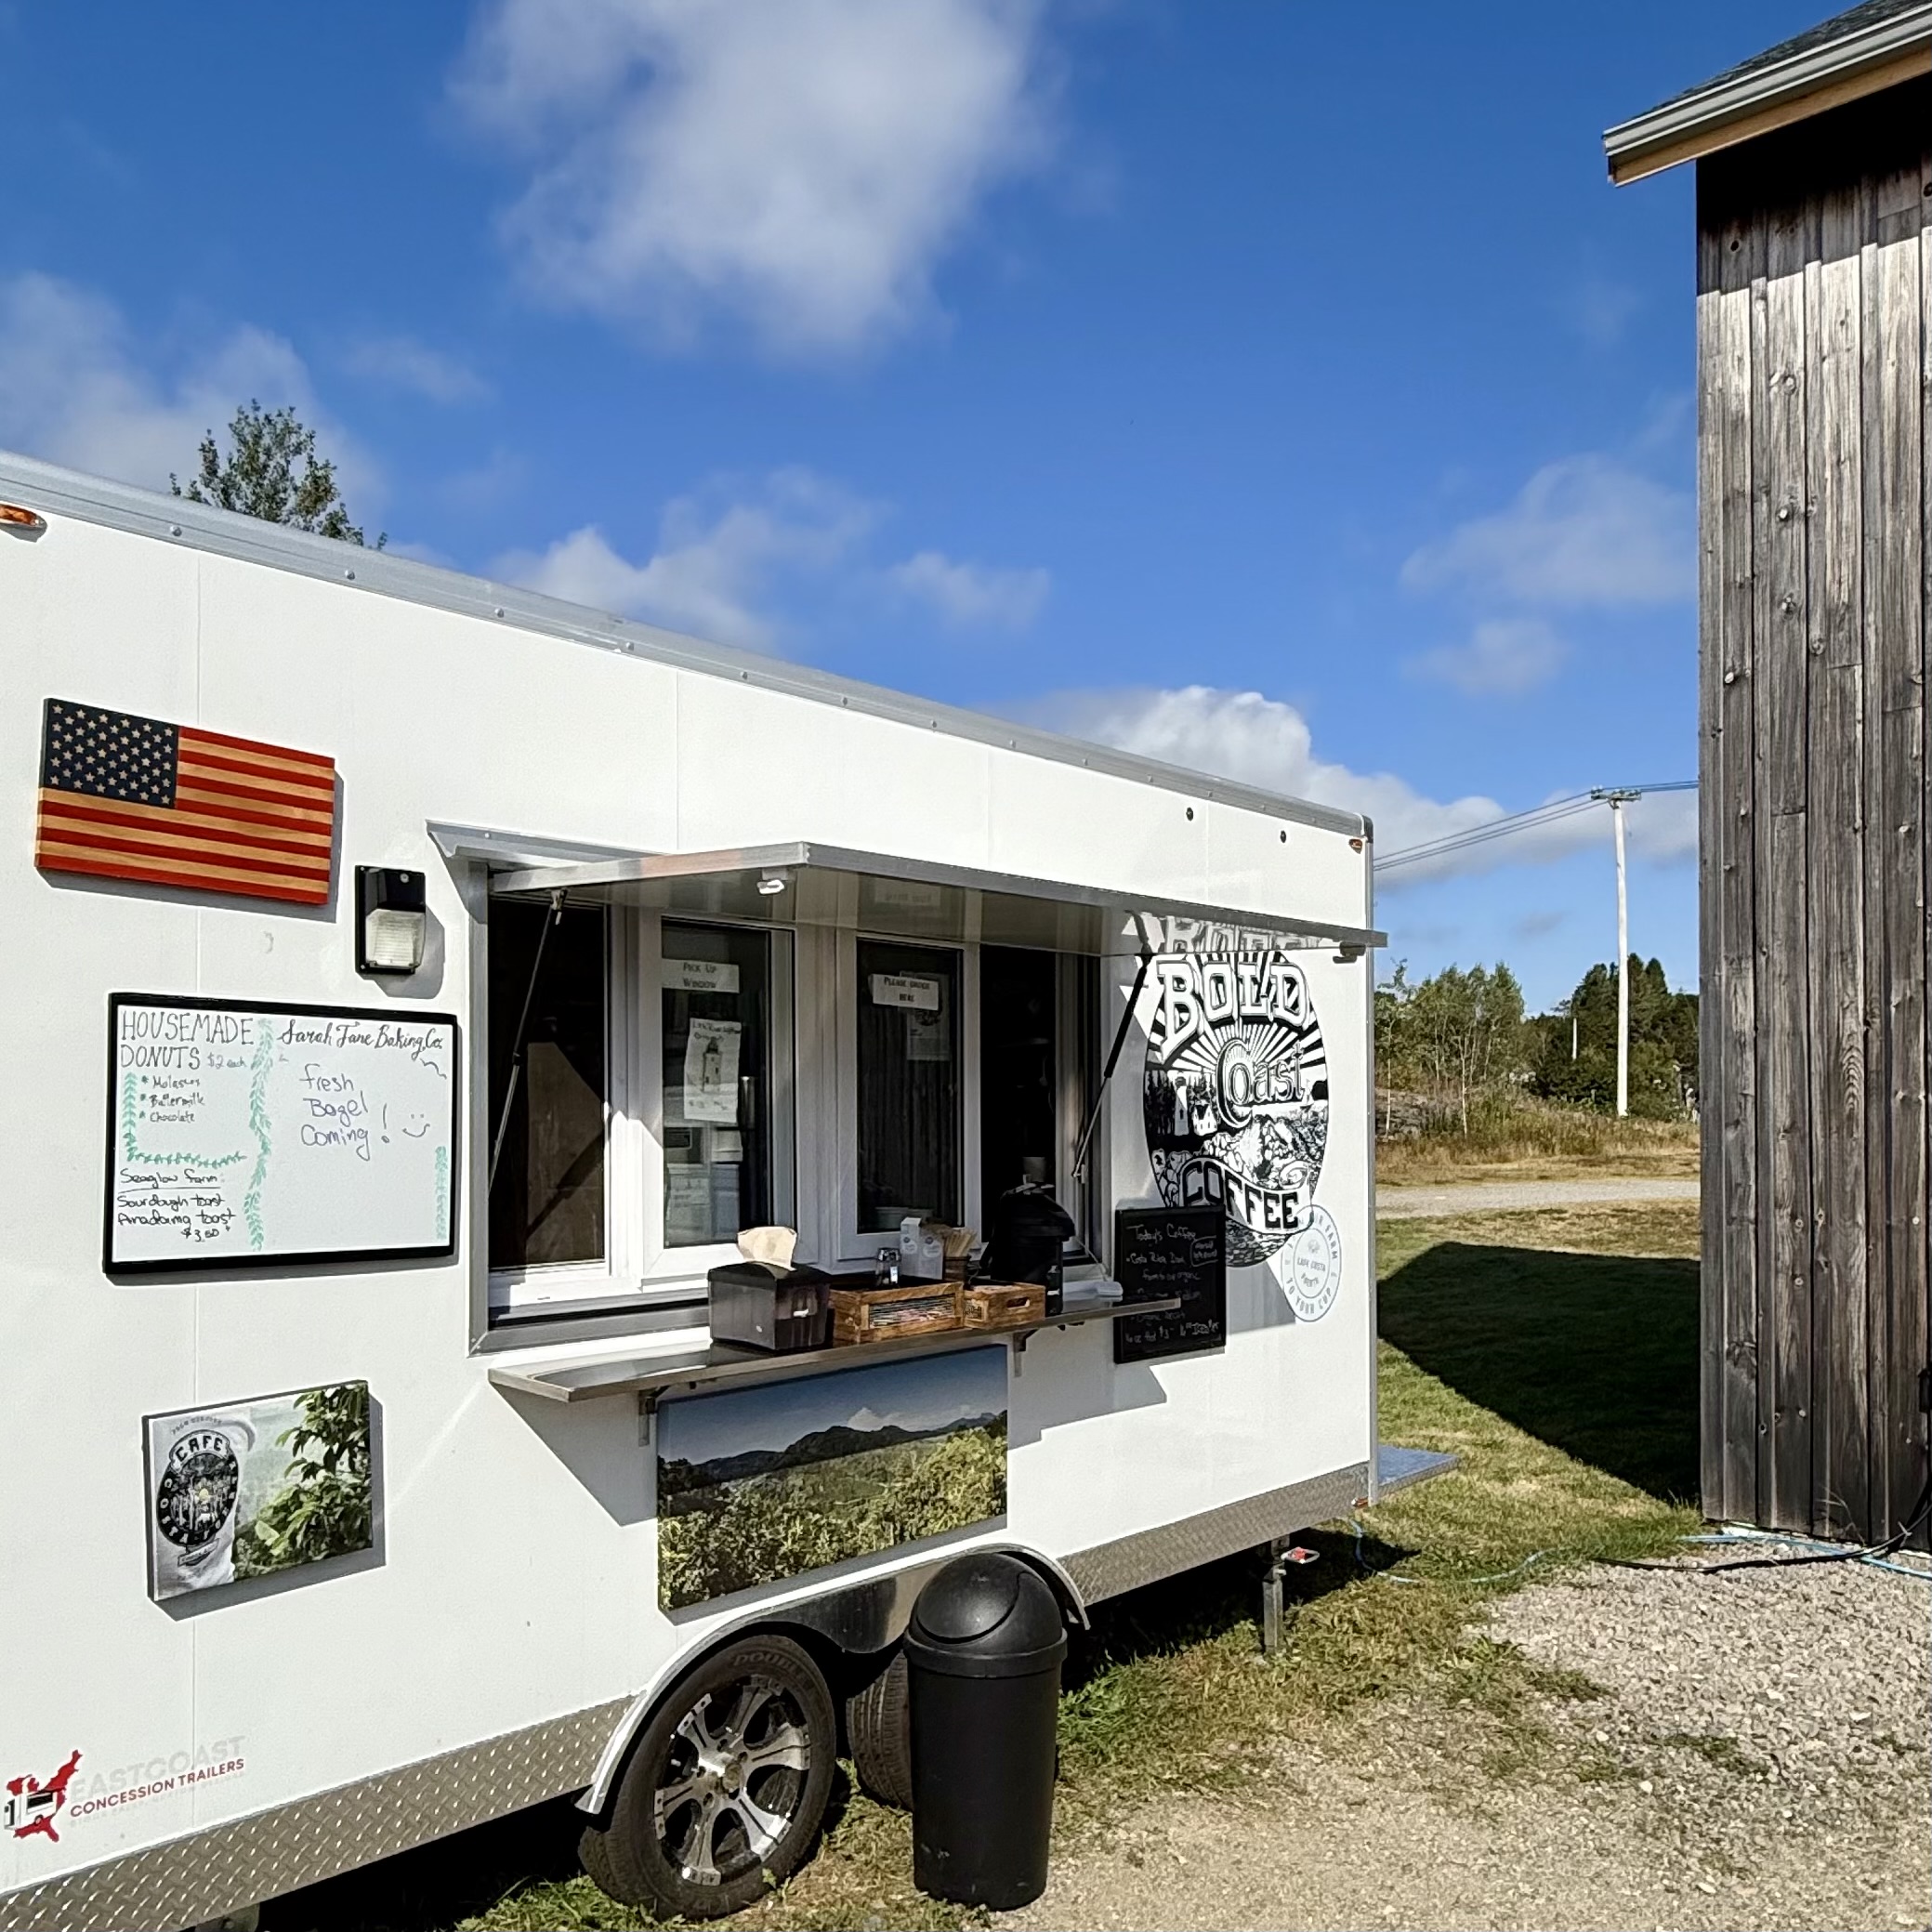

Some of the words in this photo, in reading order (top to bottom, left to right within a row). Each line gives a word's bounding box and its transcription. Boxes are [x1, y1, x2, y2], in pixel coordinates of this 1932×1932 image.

[122, 1011, 254, 1045] HOUSEMADE
[1156, 960, 1311, 1061] BOLD
[277, 1019, 333, 1045] Sarah
[121, 1044, 201, 1070] DONUTS
[207, 1052, 224, 1070] $2
[1216, 1038, 1305, 1127] Coast
[303, 1090, 368, 1127] Bagel
[301, 1124, 370, 1162] Coming
[1181, 1160, 1298, 1229] COFFEE
[175, 1435, 224, 1463] CAFE
[71, 1777, 175, 1818] CONCESSION
[177, 1757, 244, 1787] TRAILERS
